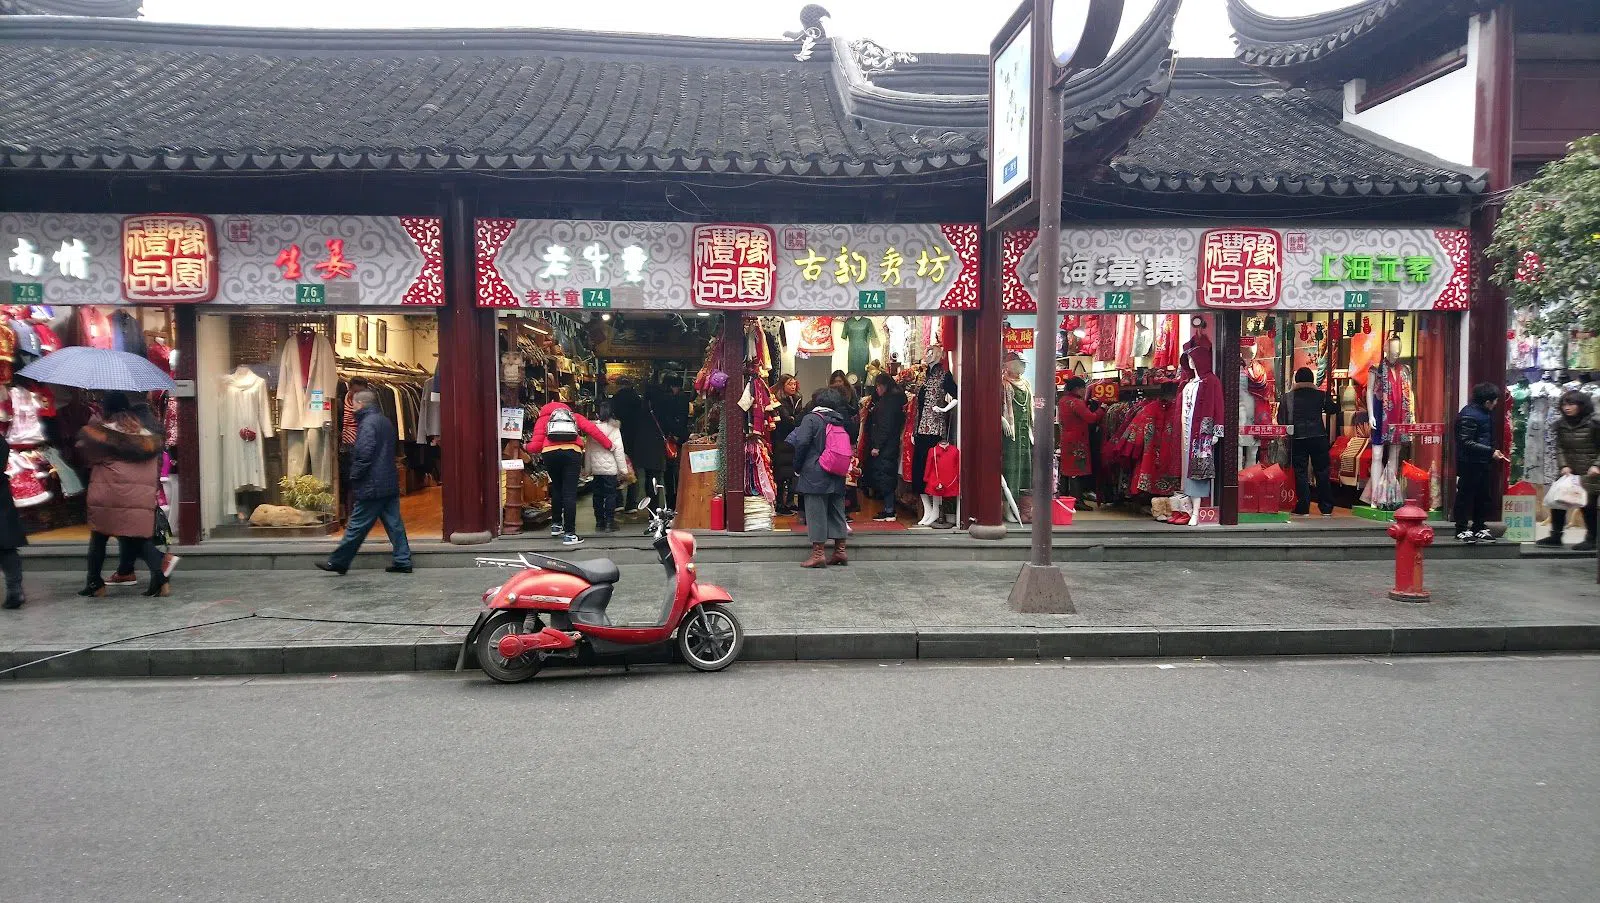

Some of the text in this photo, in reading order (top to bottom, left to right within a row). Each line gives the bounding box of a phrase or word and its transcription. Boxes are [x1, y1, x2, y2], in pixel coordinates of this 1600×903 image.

[1030, 253, 1184, 287] 海漢舞
[1310, 254, 1434, 283] 上海元素
[20, 286, 35, 296] 76
[303, 286, 317, 297] 76
[589, 290, 604, 302] 74
[526, 289, 581, 307] 老牛童
[865, 293, 879, 303] 74
[1111, 294, 1124, 304] 72
[1350, 293, 1363, 303] 70
[1094, 384, 1115, 398] 99
[1199, 509, 1215, 521] 99
